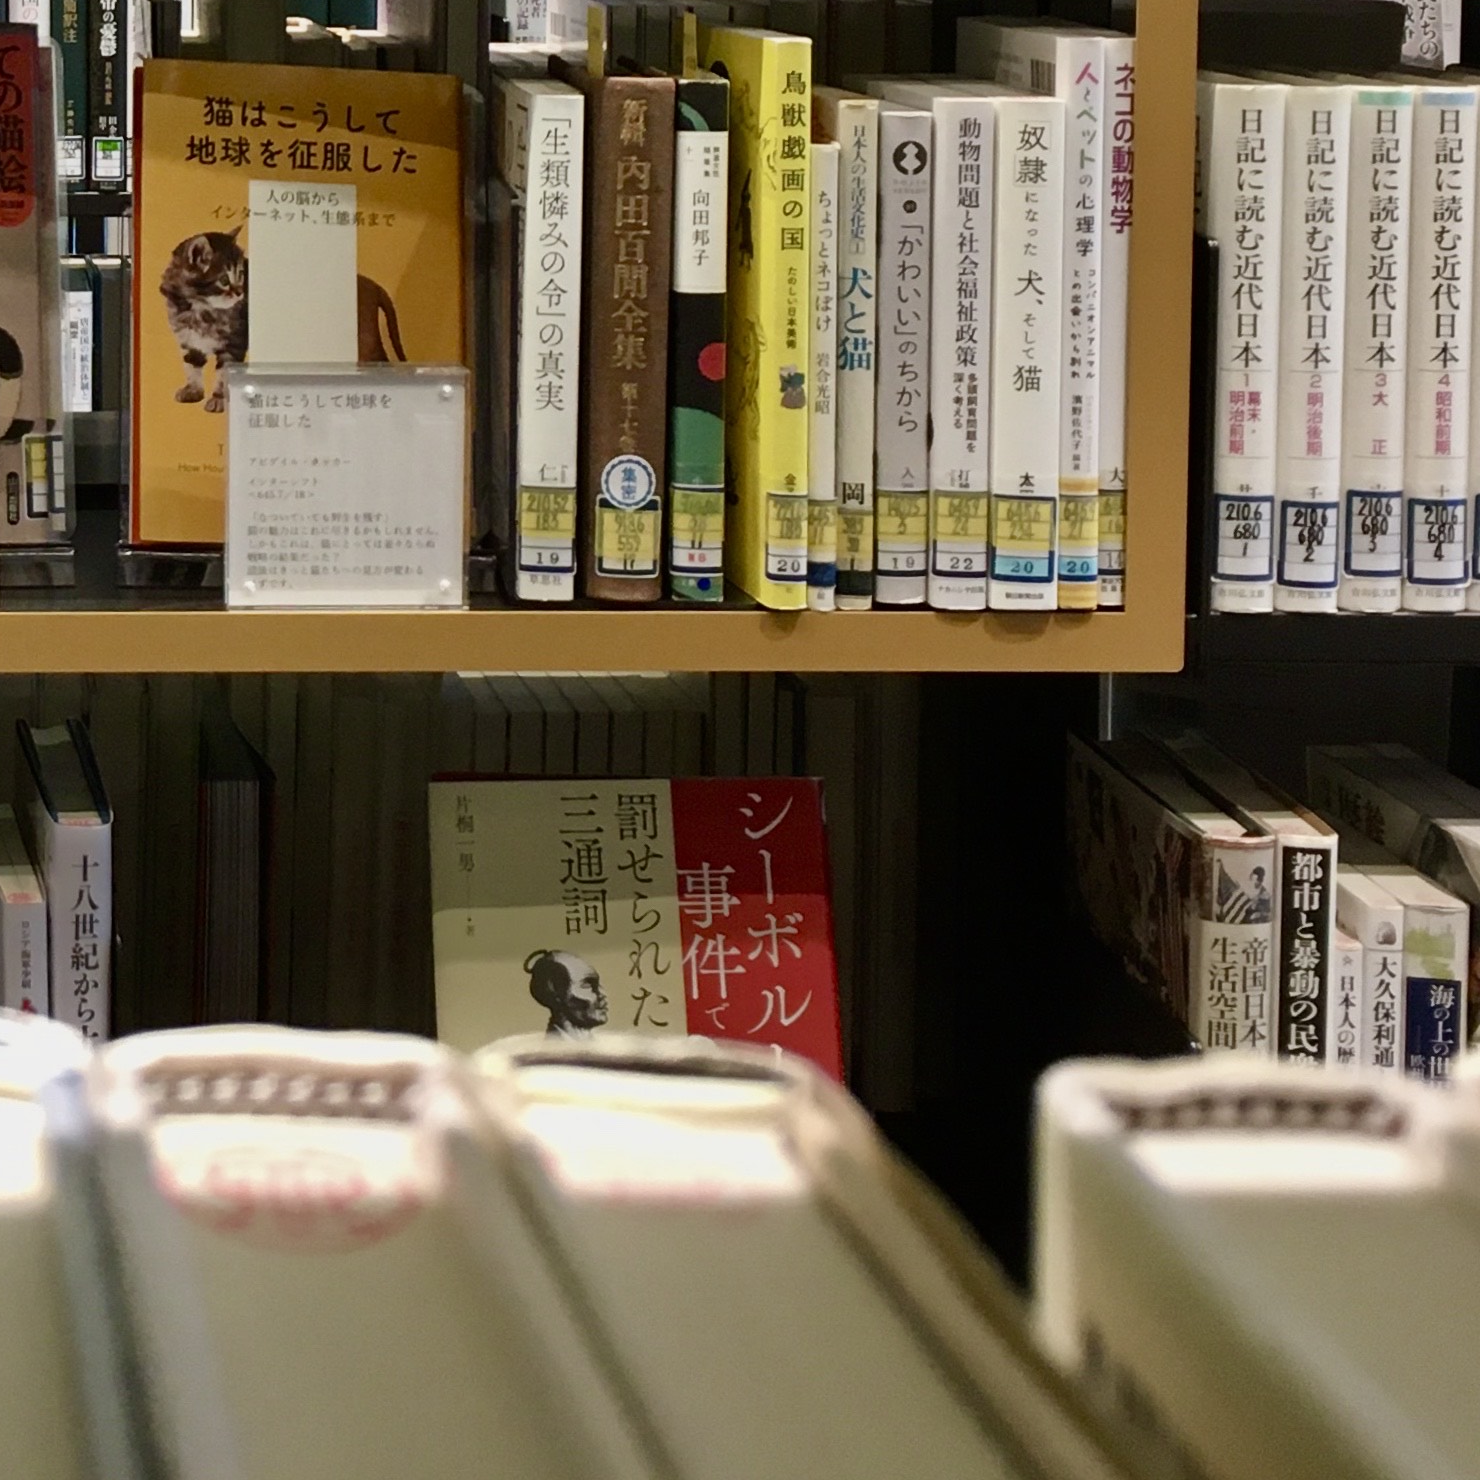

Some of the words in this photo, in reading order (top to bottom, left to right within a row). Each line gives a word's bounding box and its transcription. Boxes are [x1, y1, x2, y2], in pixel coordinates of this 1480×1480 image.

[184, 134, 419, 176] 地球を征服した
[203, 95, 403, 136] 猫はこうして
[779, 69, 808, 252] 鳥獣戯画の国
[1109, 62, 1136, 235] ネコの動物学
[265, 189, 340, 207] 人の脳から
[692, 188, 711, 268] 向田邦子
[953, 117, 982, 368] 動物問題と社会福祉政策
[1230, 108, 1267, 370] 日記に読む近代日本
[1300, 109, 1337, 370] 日記に読む近代日本
[1365, 108, 1401, 370] 日記に読む近代日本
[1429, 108, 1464, 370] 日記に読む近代日本
[535, 117, 572, 412] 「生類憐みの令」の真実
[837, 265, 873, 373] 犬と猫
[892, 223, 925, 434] 「かわいい」のちから
[248, 412, 313, 429] 征服した
[1228, 390, 1246, 456] 明治前期
[1306, 391, 1324, 457] 明治後期
[1434, 390, 1453, 456] 昭和前期
[841, 482, 865, 505] 岡
[1233, 522, 1261, 540] 680
[1428, 524, 1455, 544] 680
[536, 551, 560, 565] 19
[776, 559, 801, 573] 20
[891, 556, 916, 570] 19
[949, 556, 974, 571] 22
[455, 794, 476, 873] 片桐一男
[558, 791, 610, 937] 三通詞
[614, 791, 672, 1029] 罰せられた
[676, 861, 747, 1032] 事件で
[1207, 936, 1239, 1050] 生活空間
[1241, 936, 1269, 1049] 帝国日本
[1371, 956, 1398, 1069] 大久保利通
